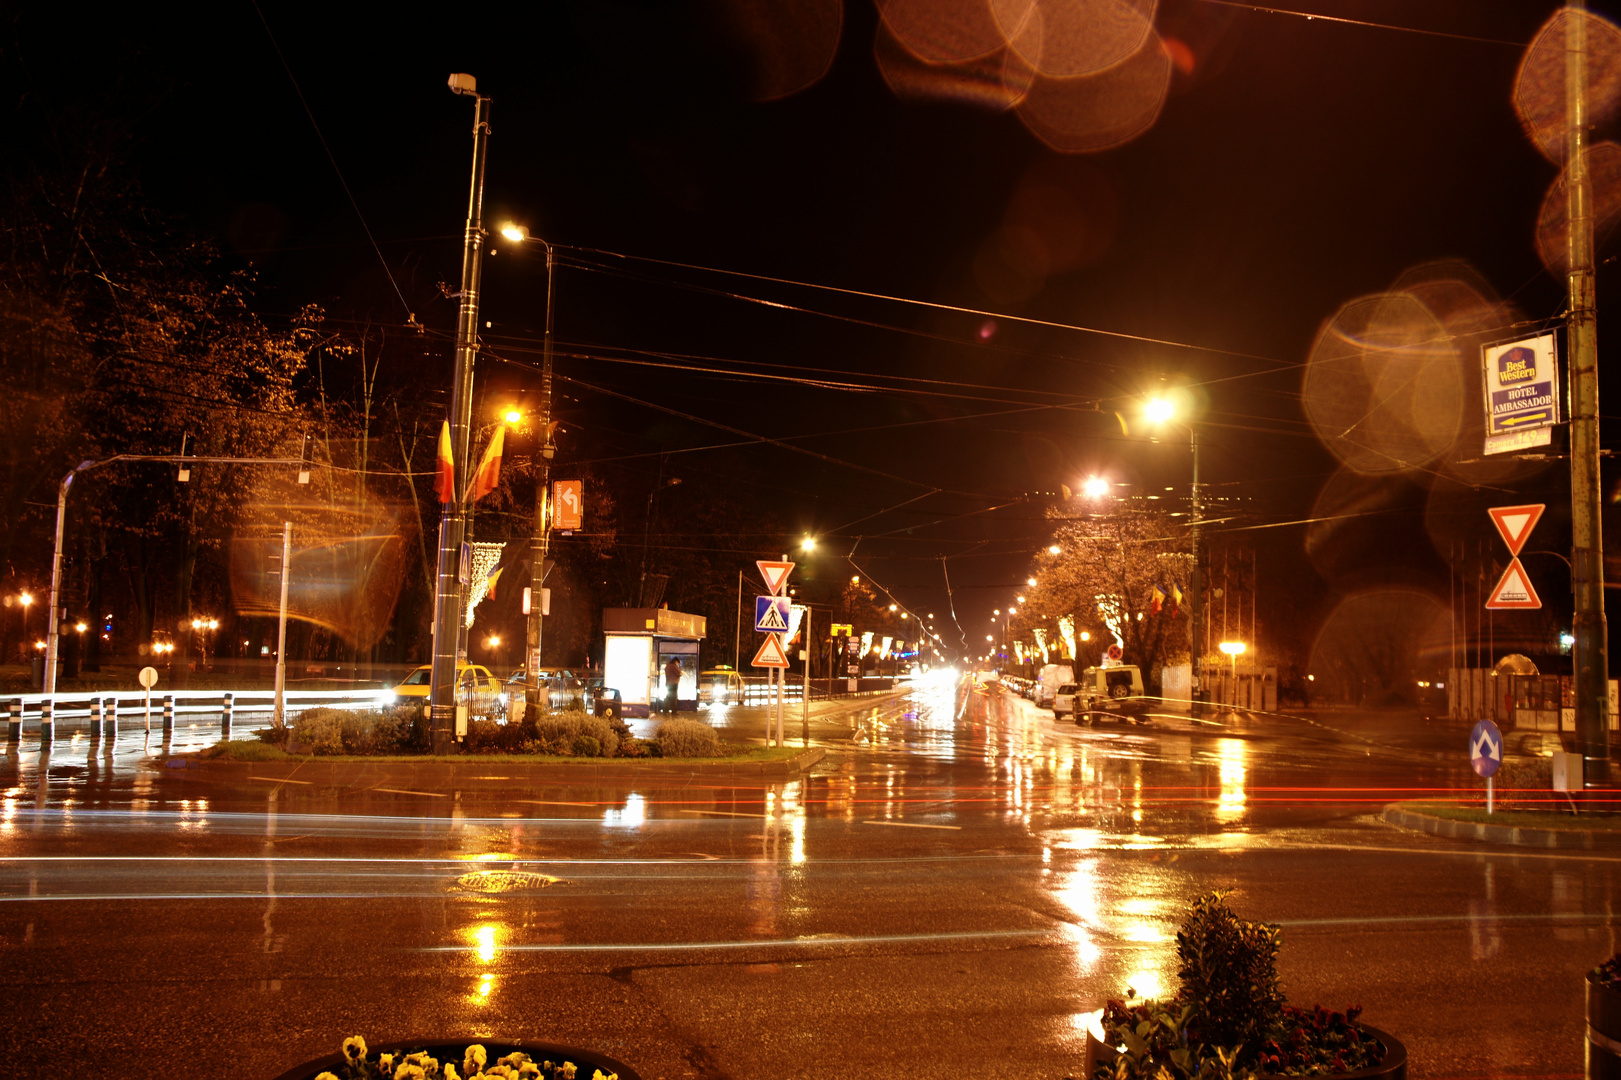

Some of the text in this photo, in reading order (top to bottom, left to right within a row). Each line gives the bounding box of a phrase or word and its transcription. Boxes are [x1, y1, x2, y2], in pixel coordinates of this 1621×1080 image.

[1506, 360, 1526, 372] Best
[1500, 367, 1535, 382] Western
[1508, 386, 1537, 400] HOTEL
[1494, 394, 1552, 414] AMBASSADOR
